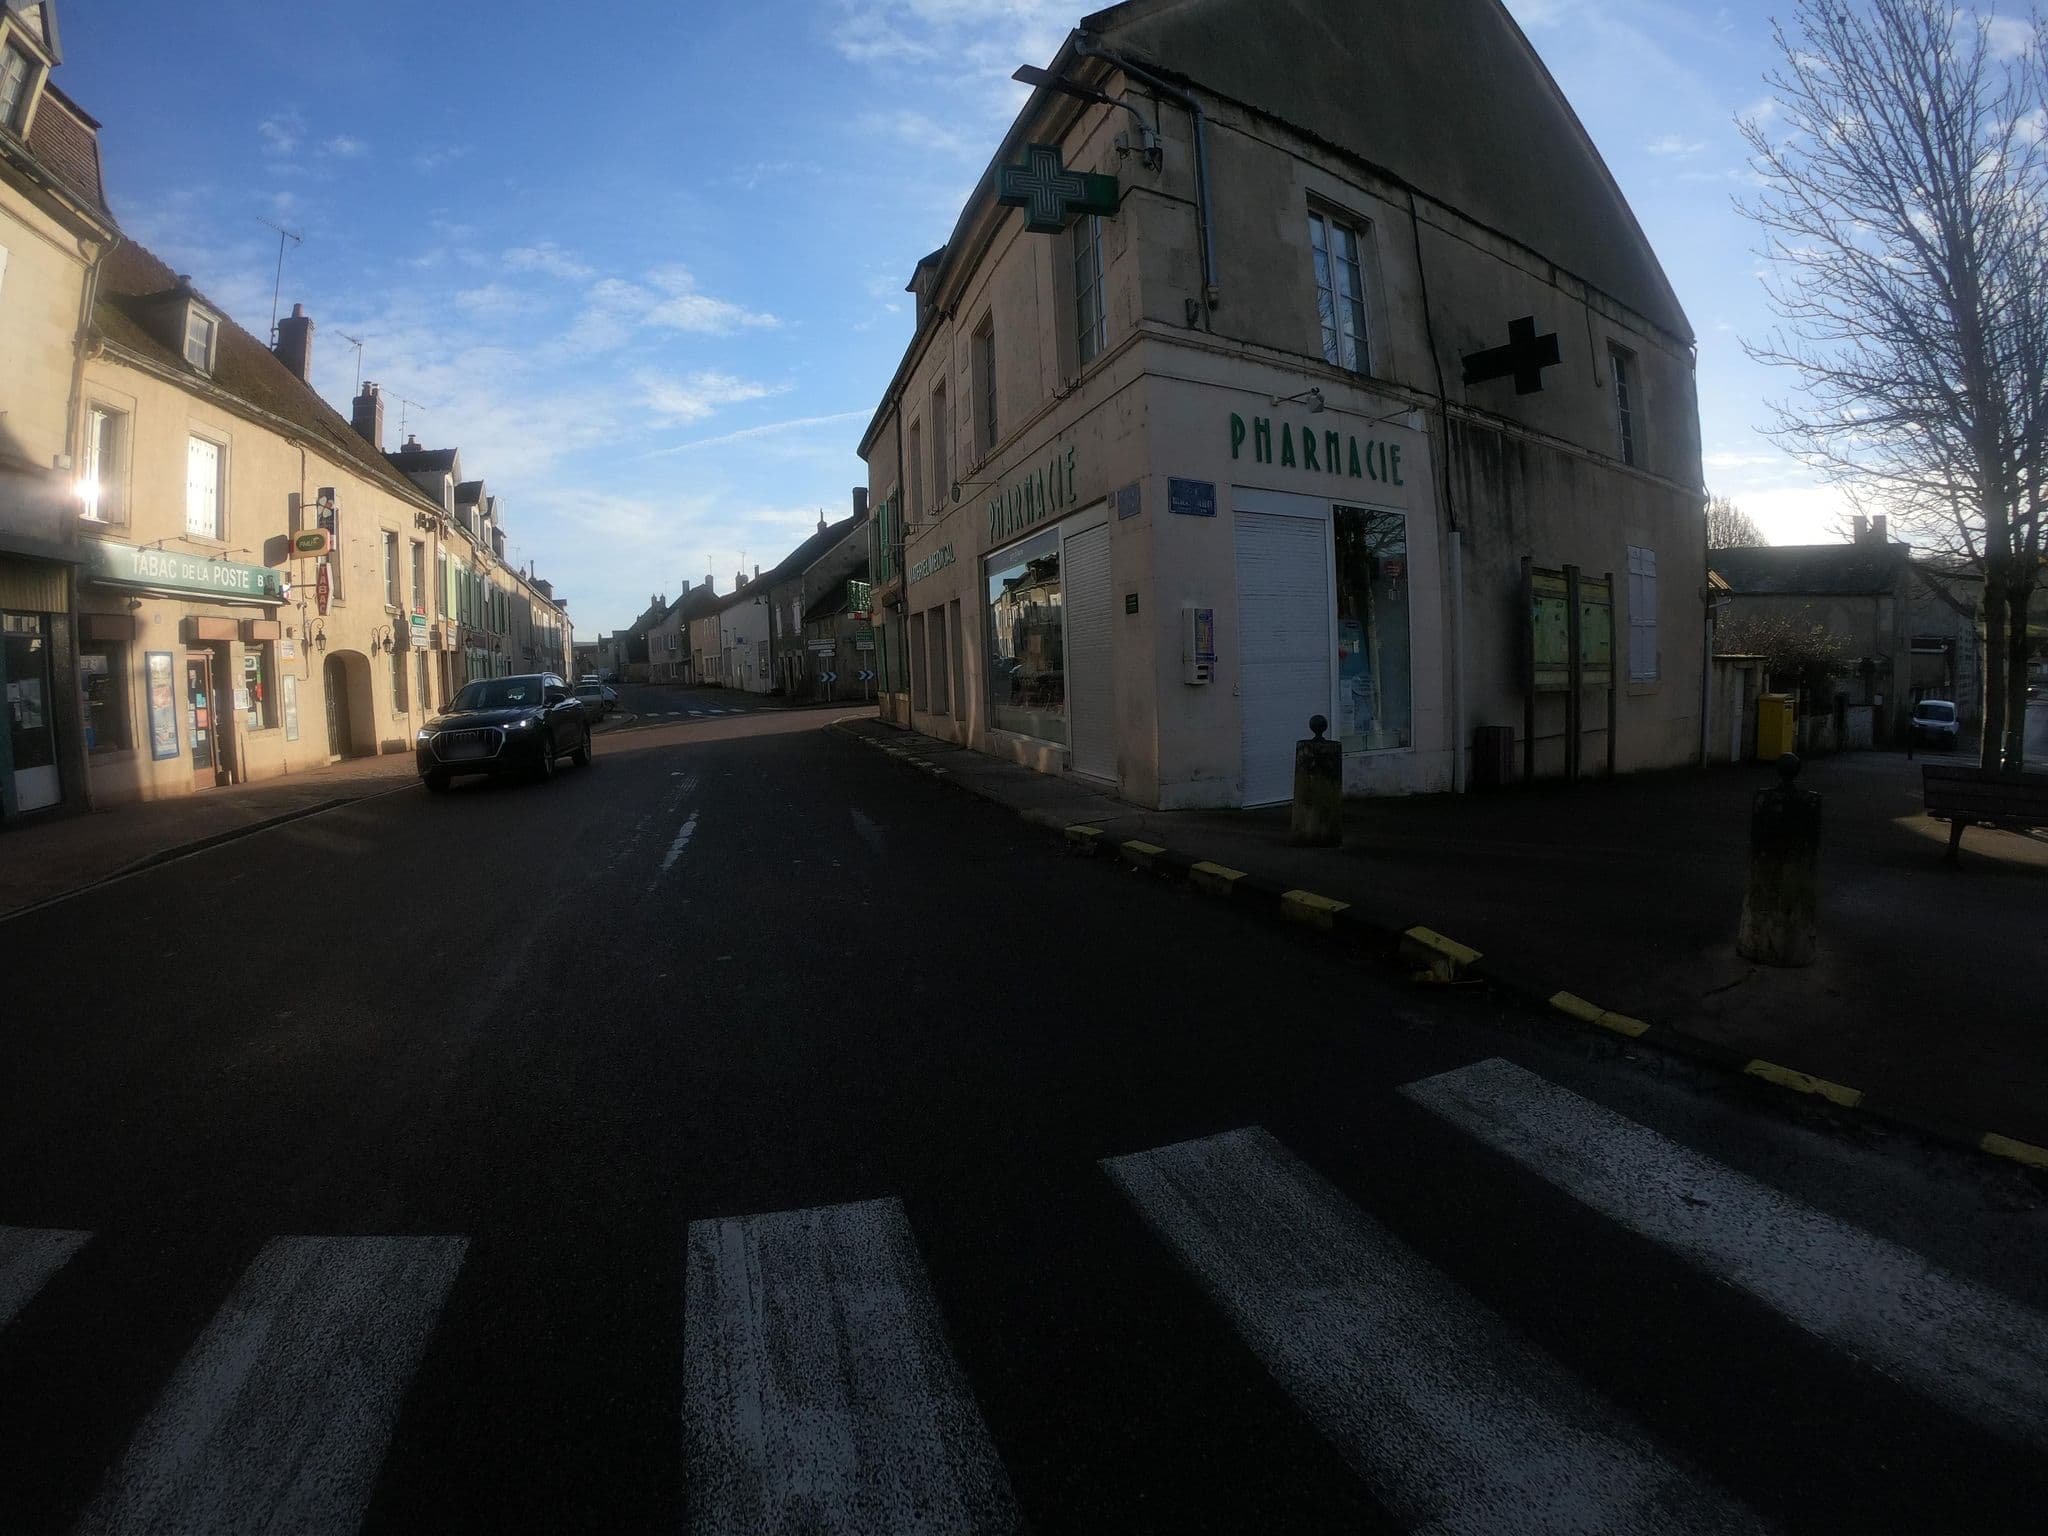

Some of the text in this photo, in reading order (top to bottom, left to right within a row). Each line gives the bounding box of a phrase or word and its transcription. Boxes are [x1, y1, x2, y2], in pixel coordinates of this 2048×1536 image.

[1231, 411, 1404, 486] PHARMACIE
[988, 446, 1077, 544] PHARMACIE
[130, 553, 178, 580] TABAC
[182, 563, 195, 580] DE
[196, 565, 210, 583] LA
[213, 565, 250, 589] POSTE
[318, 565, 327, 613] TABAC
